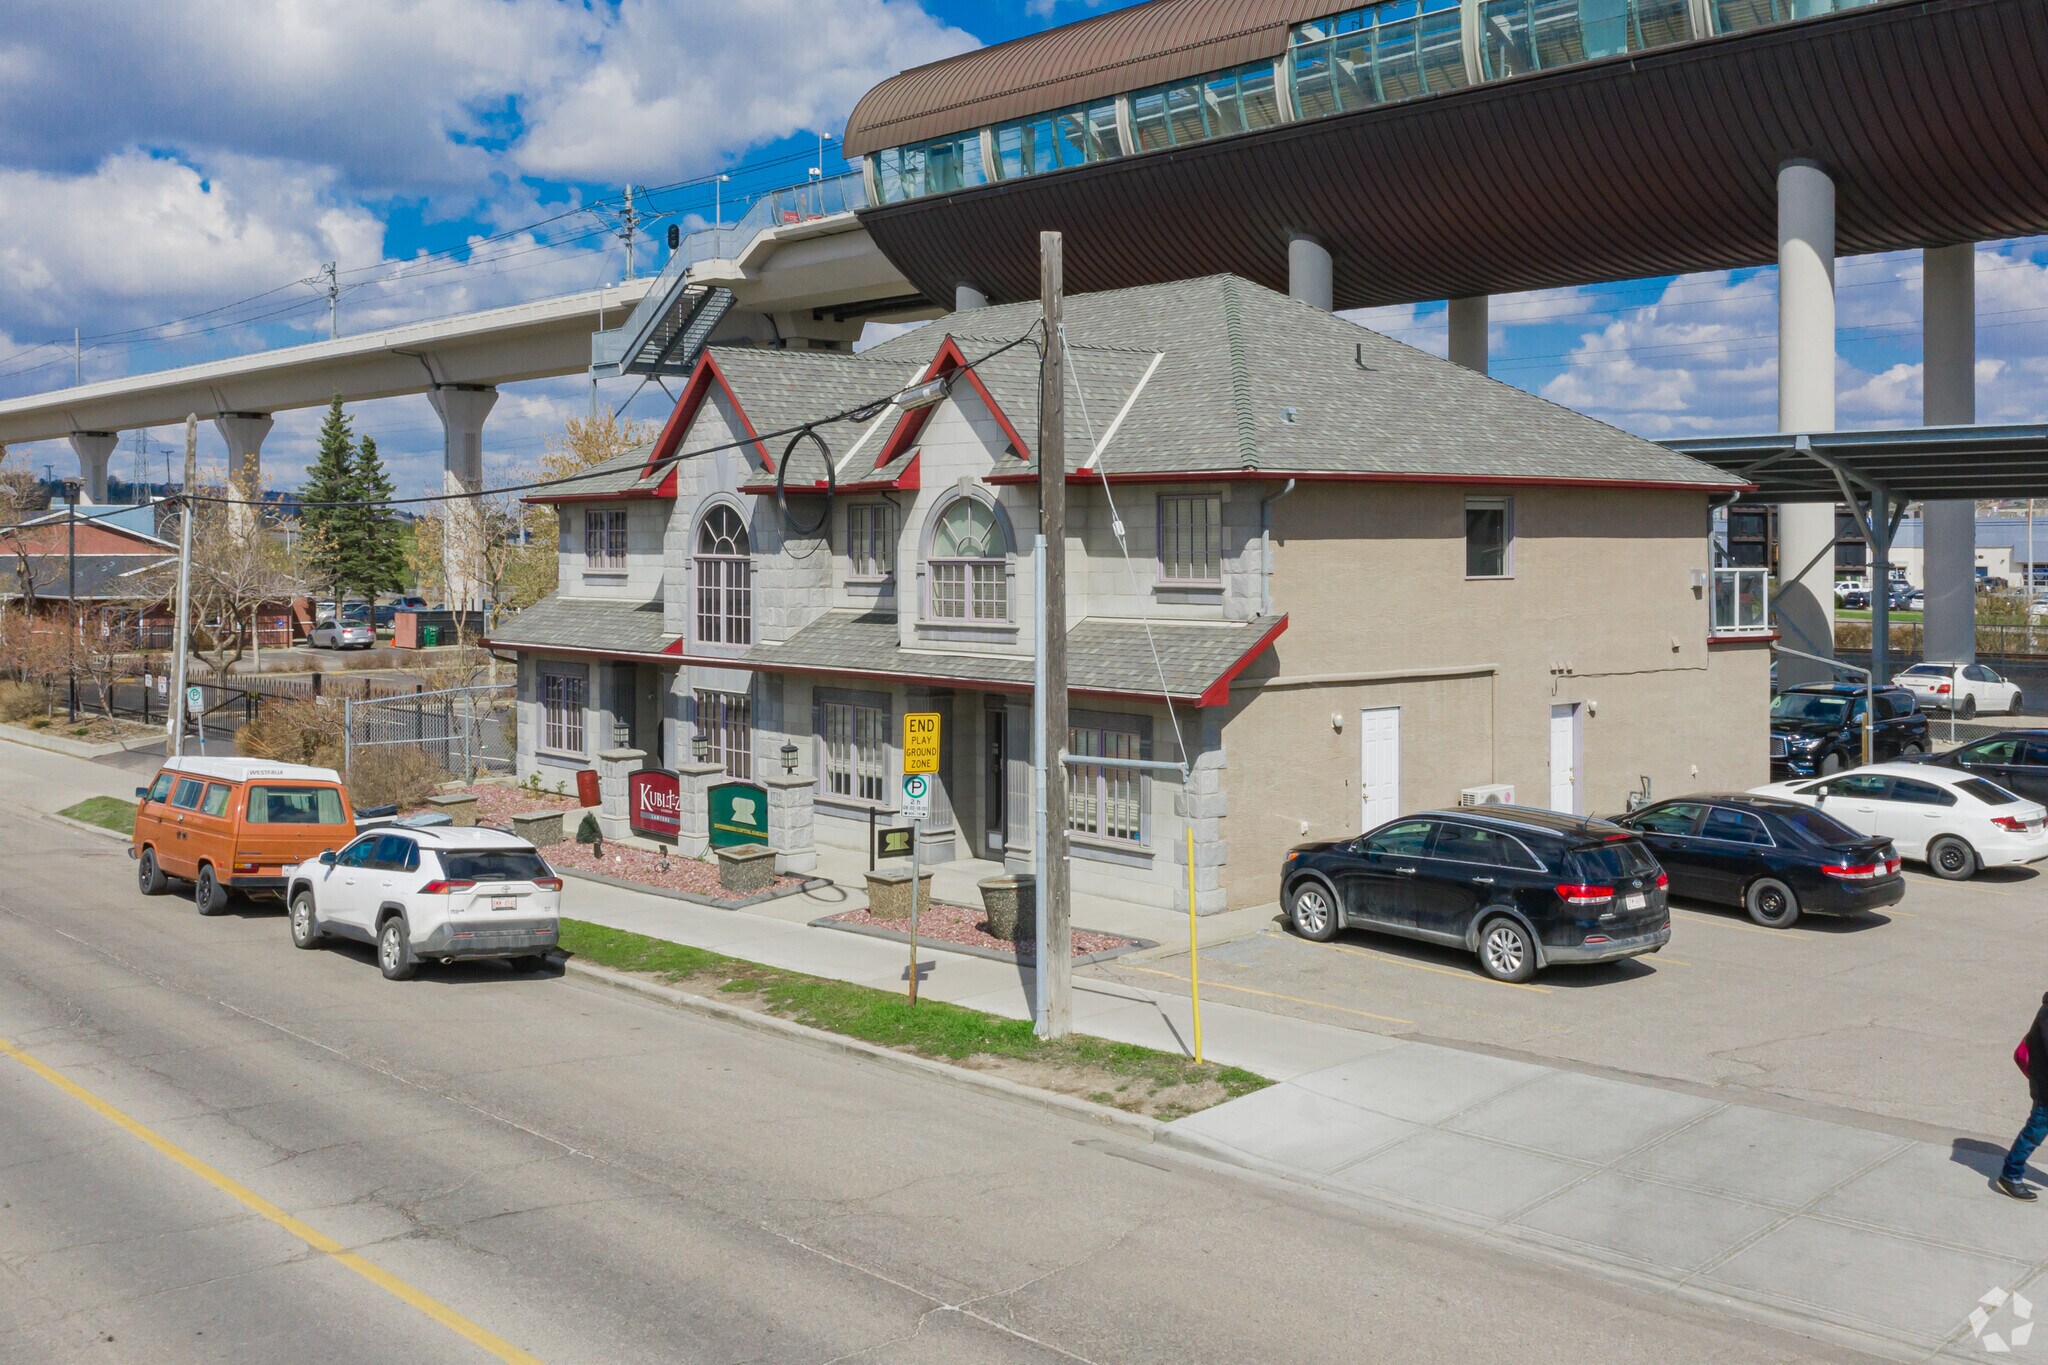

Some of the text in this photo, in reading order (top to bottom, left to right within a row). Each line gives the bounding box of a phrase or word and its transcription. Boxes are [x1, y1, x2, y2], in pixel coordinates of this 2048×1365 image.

[910, 719, 935, 732] END
[911, 736, 932, 745] PLAY
[906, 747, 937, 757] GROUND
[911, 759, 931, 769] ZONE
[911, 780, 922, 794] P
